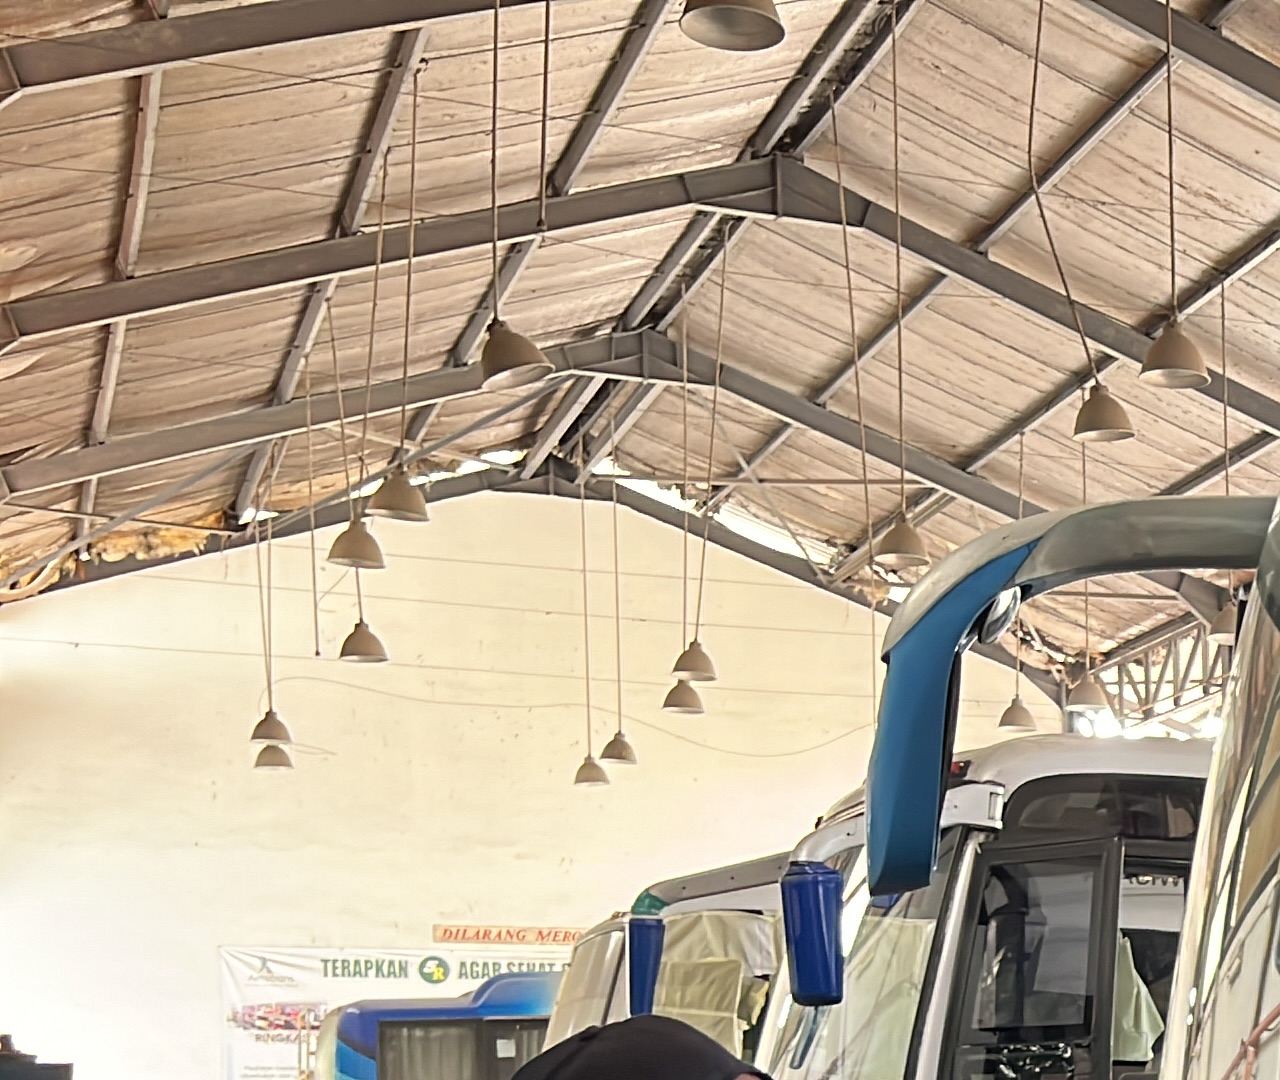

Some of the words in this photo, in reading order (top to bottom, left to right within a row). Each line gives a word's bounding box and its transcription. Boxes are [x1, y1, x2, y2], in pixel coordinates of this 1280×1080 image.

[442, 928, 527, 942] DILARANG
[320, 958, 409, 979] TERAPKAN
[458, 961, 501, 980] AGAR
